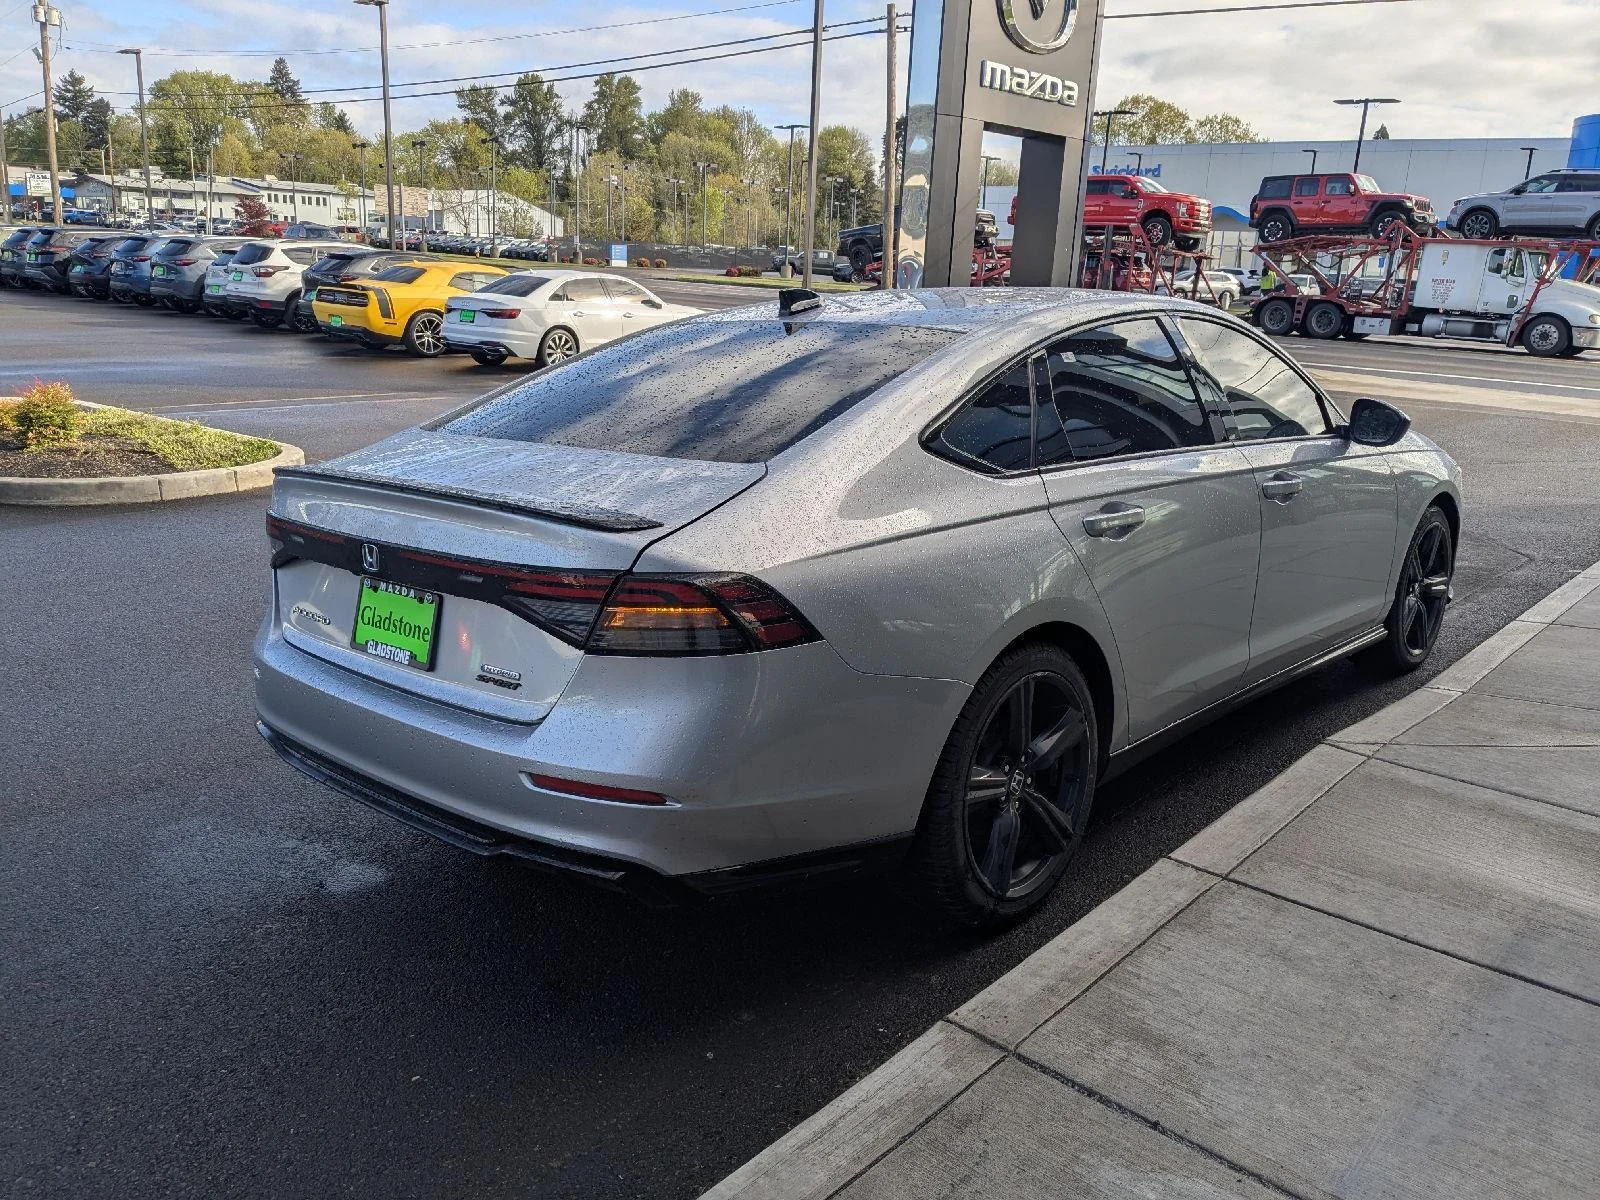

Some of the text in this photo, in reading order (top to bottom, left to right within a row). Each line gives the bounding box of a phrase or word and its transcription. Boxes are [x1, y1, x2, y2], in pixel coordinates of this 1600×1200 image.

[380, 581, 415, 598] MAZDA
[360, 606, 430, 642] Gladstone
[367, 640, 411, 665] GLADSTONE
[475, 674, 522, 690] SPORT
